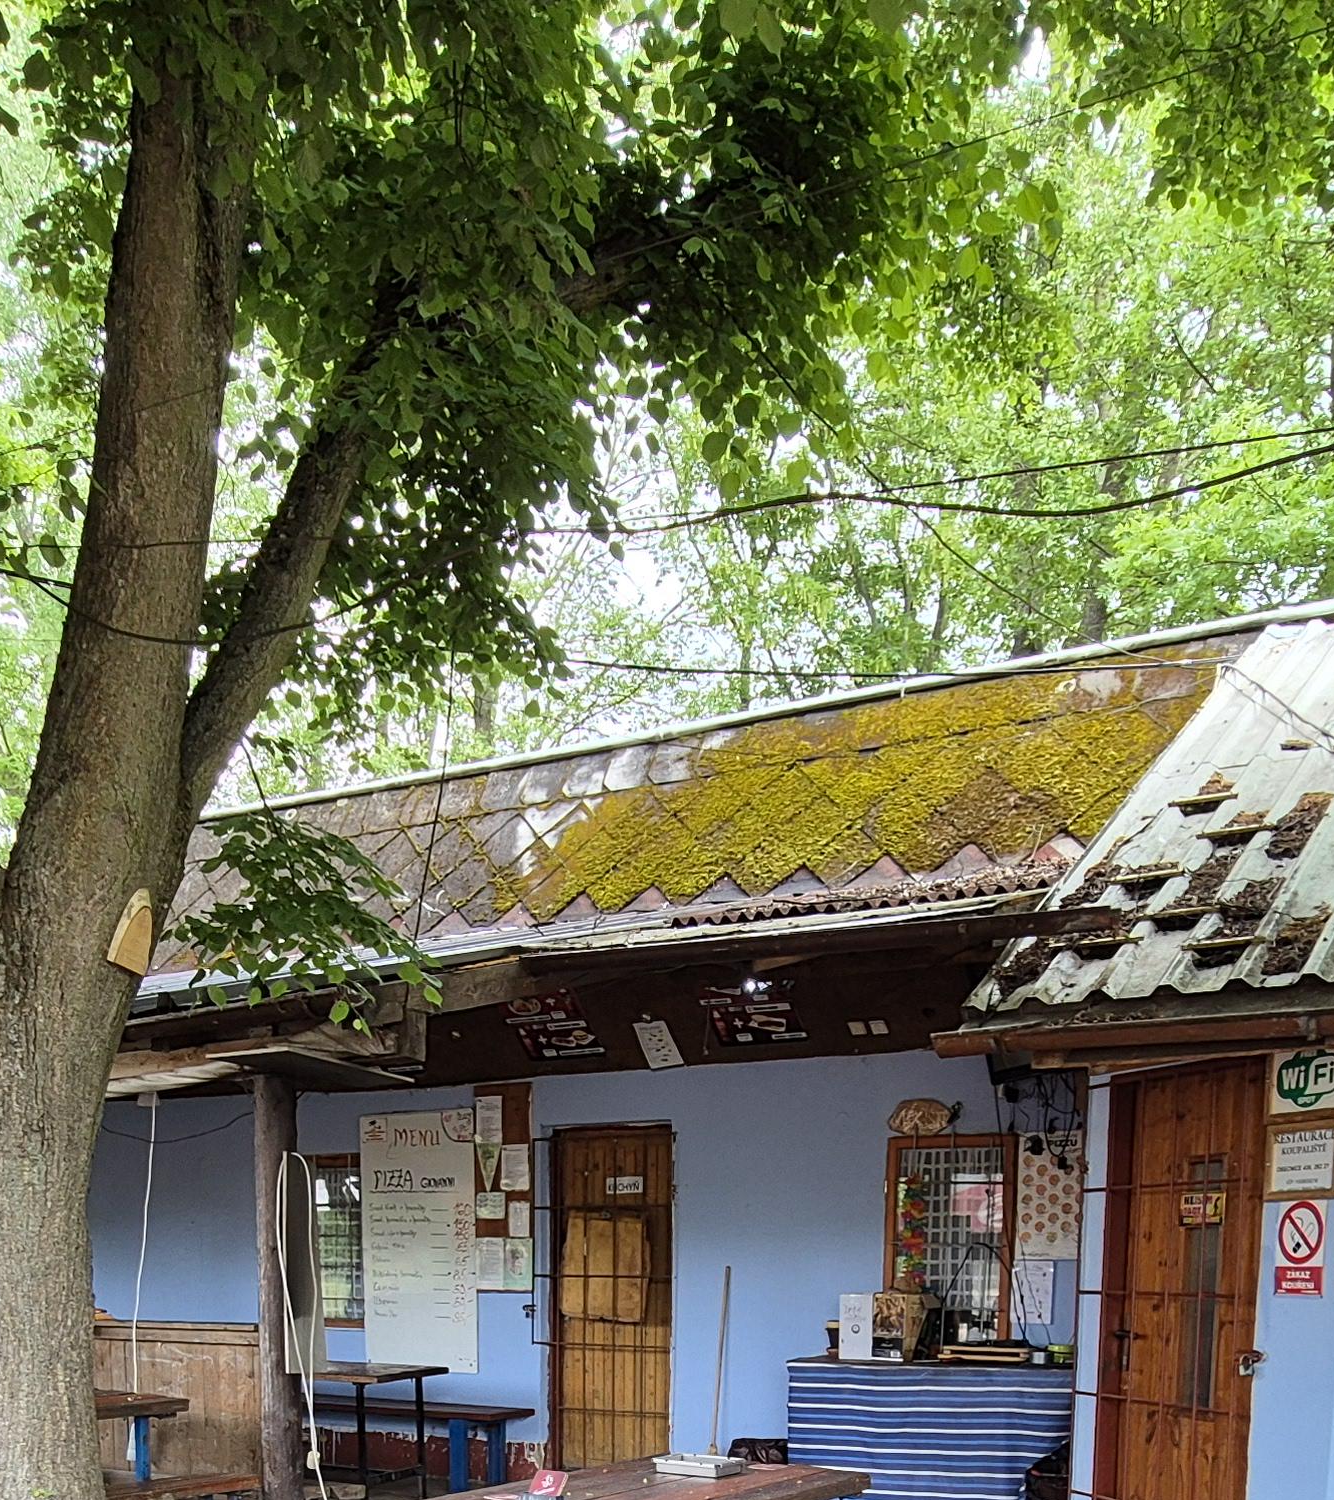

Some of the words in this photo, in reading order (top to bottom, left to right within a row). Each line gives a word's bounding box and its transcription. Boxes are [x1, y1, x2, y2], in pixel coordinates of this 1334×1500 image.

[393, 1128, 441, 1148] MENU
[373, 1168, 414, 1190] PIZZA
[608, 1180, 640, 1191] KCHYŇ
